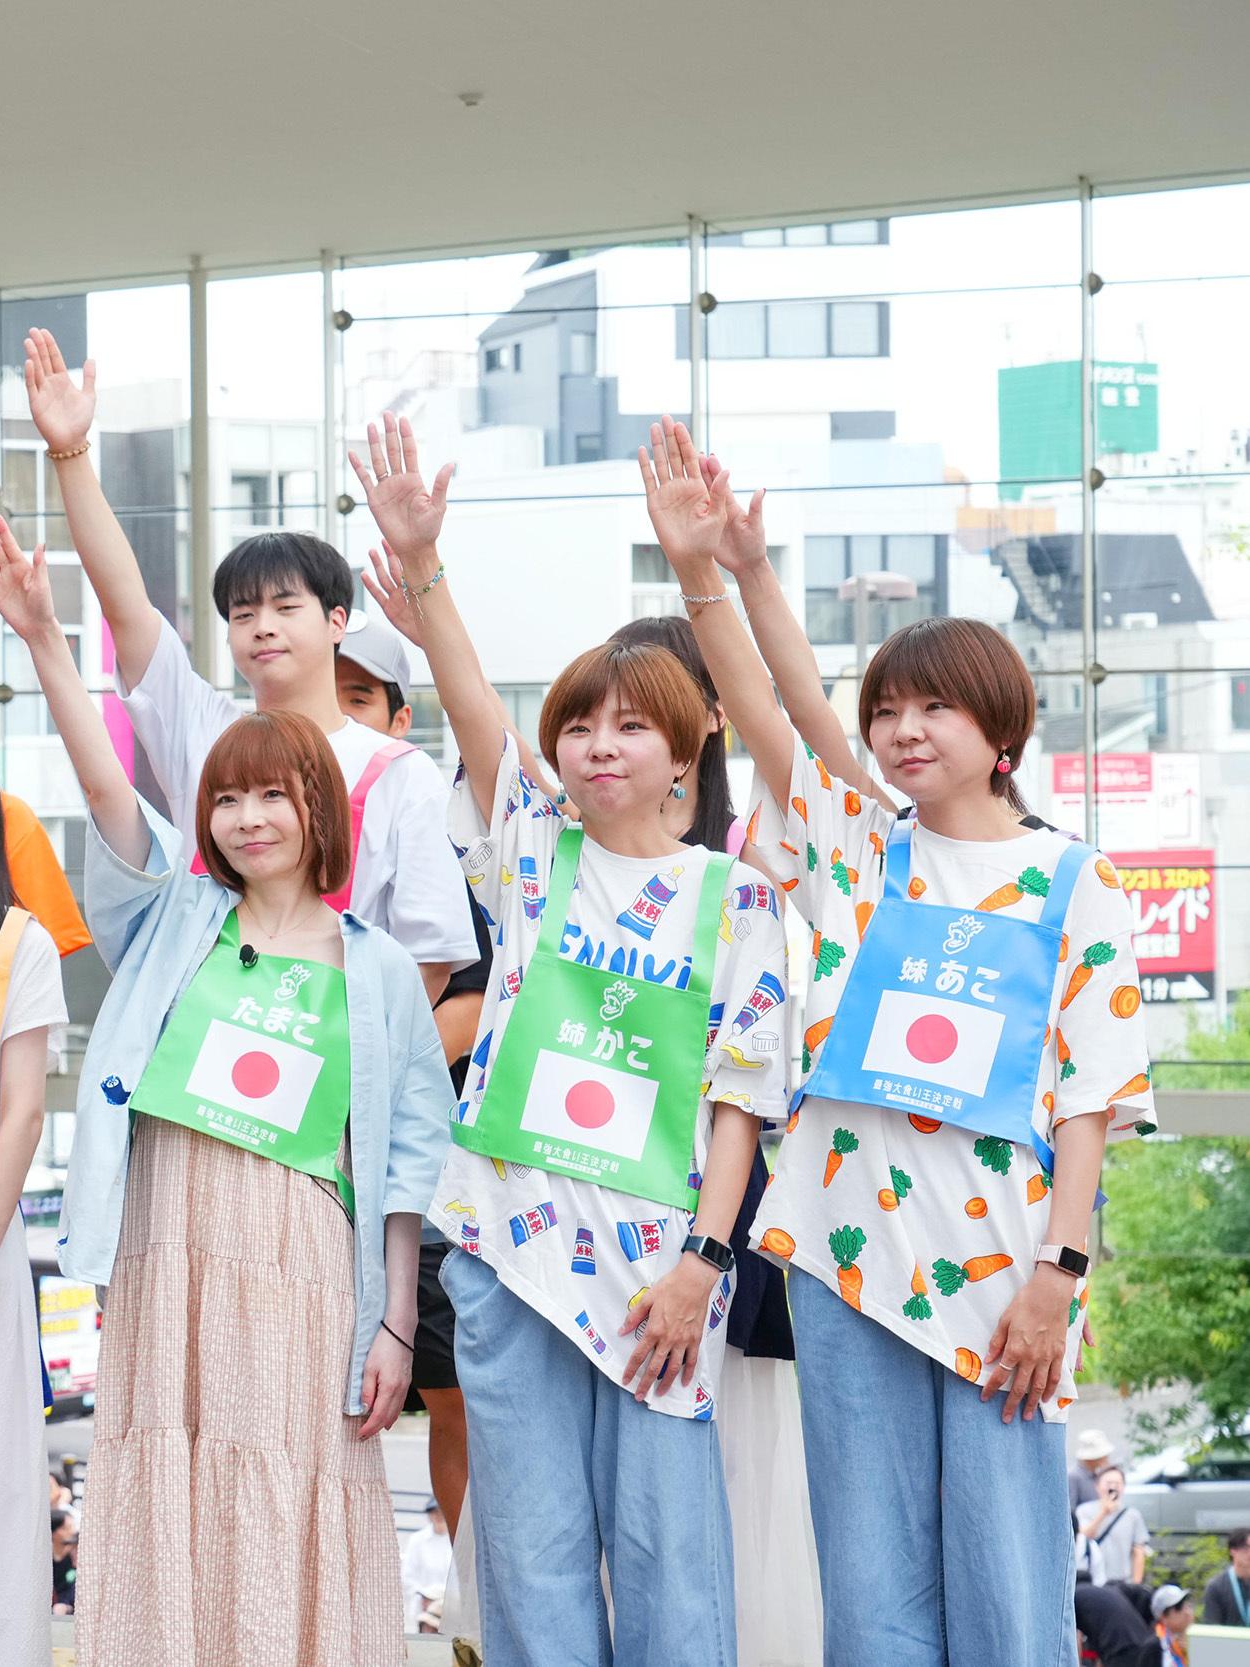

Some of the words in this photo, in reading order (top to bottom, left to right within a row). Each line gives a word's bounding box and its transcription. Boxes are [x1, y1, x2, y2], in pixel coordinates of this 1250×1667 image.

[1130, 887, 1211, 934] レイド
[899, 956, 928, 984] 妹
[935, 959, 1001, 1003] あこ
[230, 996, 321, 1046] たまこ
[556, 1018, 586, 1049] 姉
[591, 1026, 654, 1071] かこ
[873, 1079, 963, 1110] 最強大食い王決定戦
